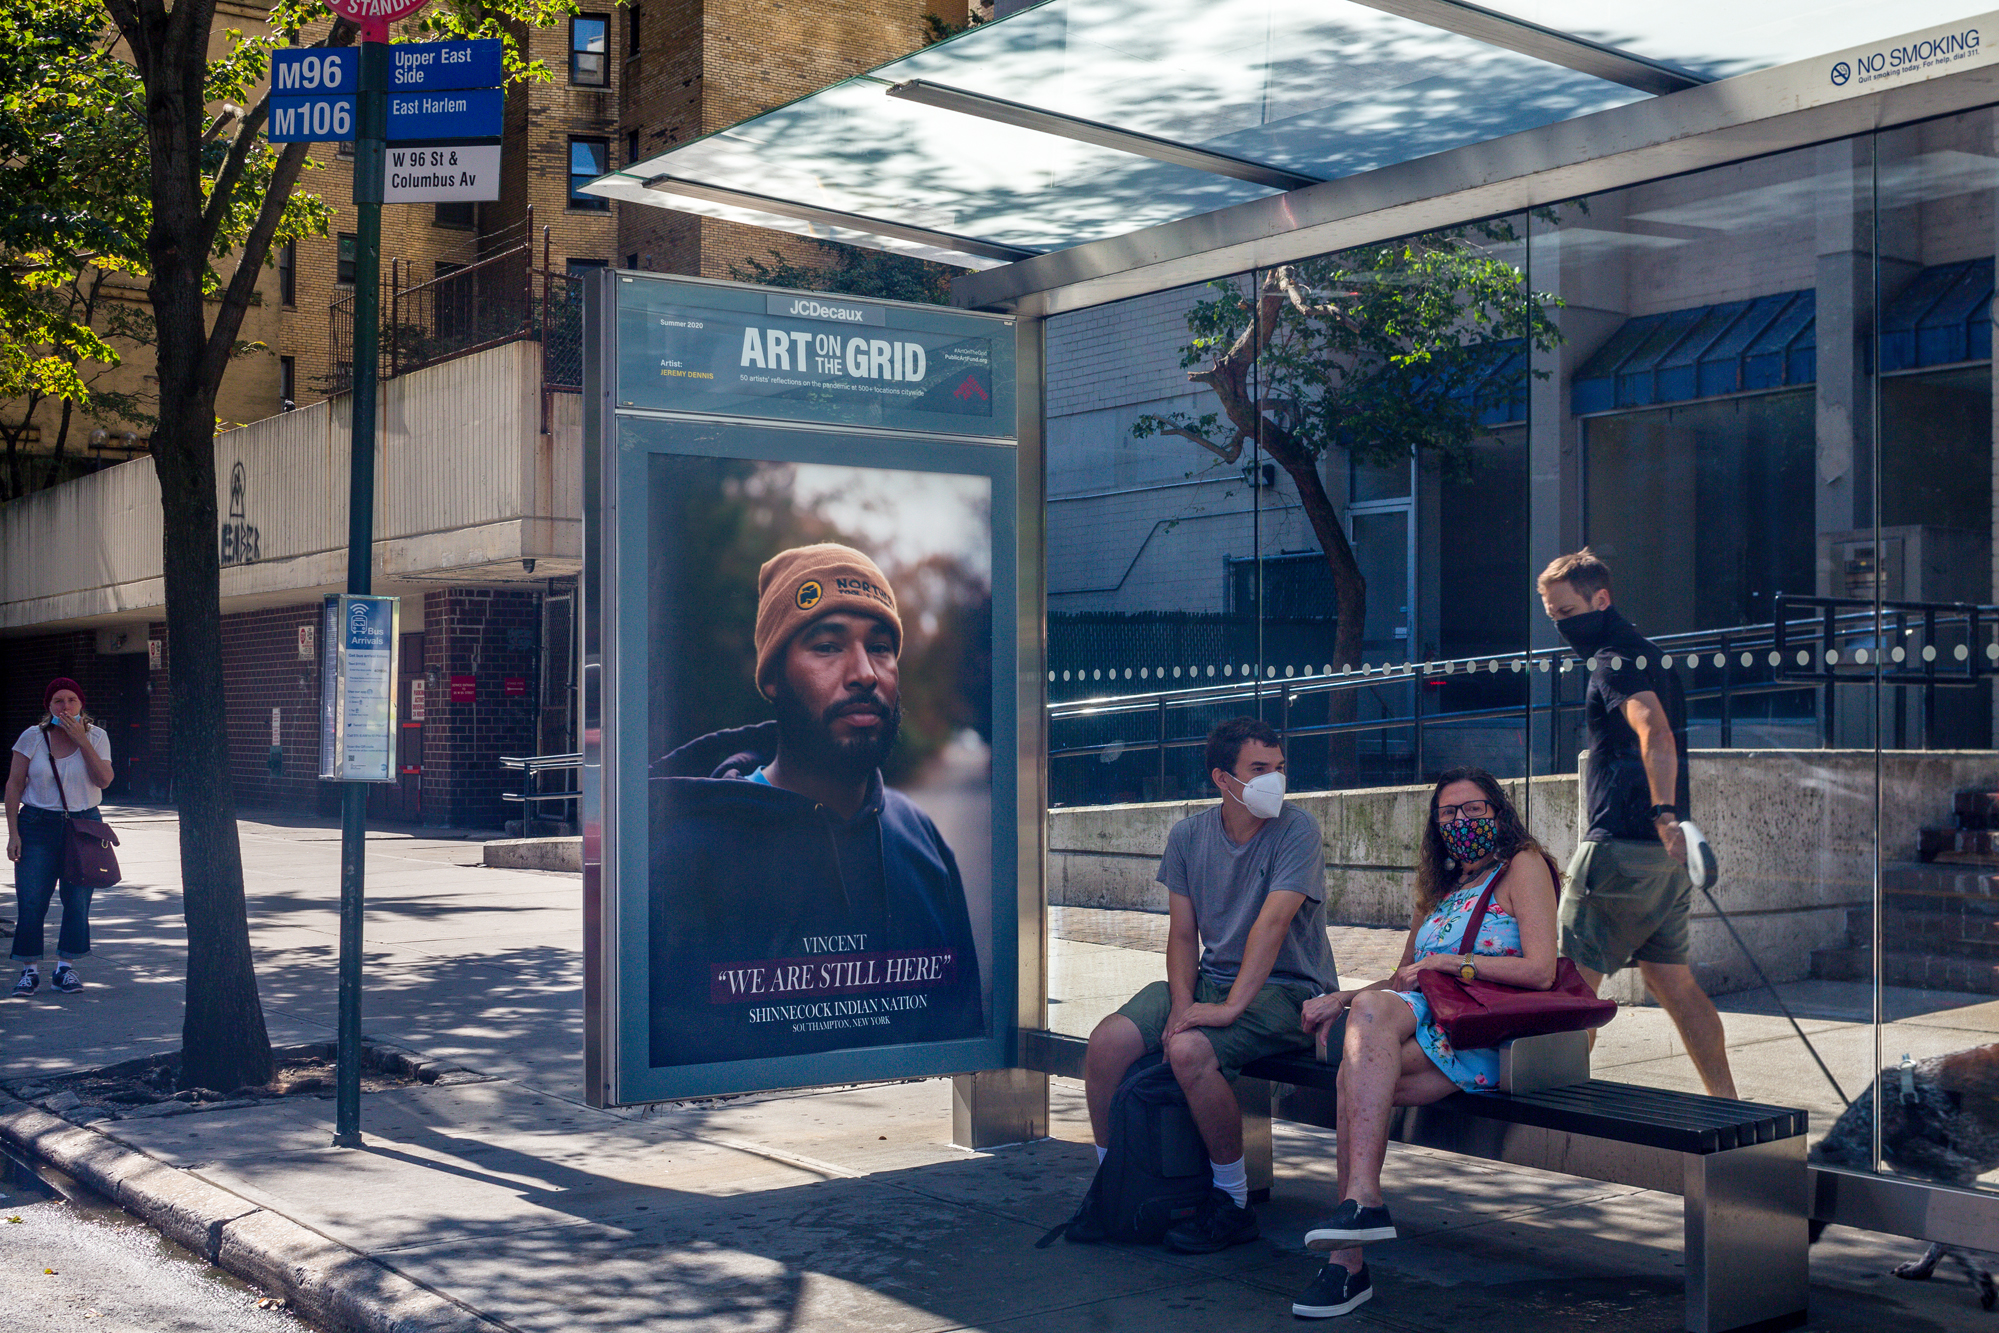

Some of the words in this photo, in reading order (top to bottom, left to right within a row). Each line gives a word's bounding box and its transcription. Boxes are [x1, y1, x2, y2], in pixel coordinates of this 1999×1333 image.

[395, 51, 436, 69] Upper
[441, 48, 472, 64] East
[1857, 52, 1886, 76] NO
[1889, 29, 1980, 67] SMOKING
[278, 55, 342, 89] M96
[394, 67, 424, 84] Side
[1858, 75, 1872, 84] Quit
[1873, 69, 1901, 81] smoking
[1922, 60, 1934, 68] For
[1935, 56, 1952, 67] help,
[1953, 52, 1966, 61] dial
[393, 99, 419, 115] East
[422, 97, 467, 114] Harlem
[274, 101, 351, 136] M106
[393, 152, 405, 167] W
[409, 152, 426, 167] 96
[430, 151, 444, 166] St
[448, 151, 458, 166] &
[391, 172, 455, 189] Columbus
[459, 171, 476, 186] Av
[789, 299, 863, 322] JCDecaux
[660, 319, 687, 328] Summer
[687, 321, 704, 329] 2020
[740, 327, 812, 373] ART
[815, 333, 841, 357] ON
[660, 359, 683, 368] Artist:
[815, 355, 843, 376] THE
[845, 337, 926, 383] GRID
[944, 354, 988, 364] PublicArtFund.org
[660, 369, 687, 378] JEREMY
[687, 371, 714, 380] DENNIS
[739, 374, 749, 382] 50
[749, 374, 770, 383] artists'
[770, 377, 802, 386] reflections
[811, 380, 822, 388] the
[822, 382, 851, 391] pandemic
[858, 384, 874, 392] 500+
[873, 386, 901, 395] locations
[901, 388, 925, 397] citywide
[351, 636, 384, 645] Arrivals
[367, 627, 384, 636] Bus
[802, 933, 868, 953] VINCENT
[718, 968, 765, 995] “WE
[770, 964, 815, 993] ARE
[818, 960, 882, 989] STILL
[885, 954, 952, 983] HERE”
[749, 1001, 832, 1024] SHINNECOCK
[834, 998, 878, 1016] INDIAN
[880, 994, 928, 1013] NATION
[792, 1019, 852, 1033] SOUTHAMPTON,
[852, 1017, 871, 1028] NEW
[871, 1015, 891, 1027] YORK
